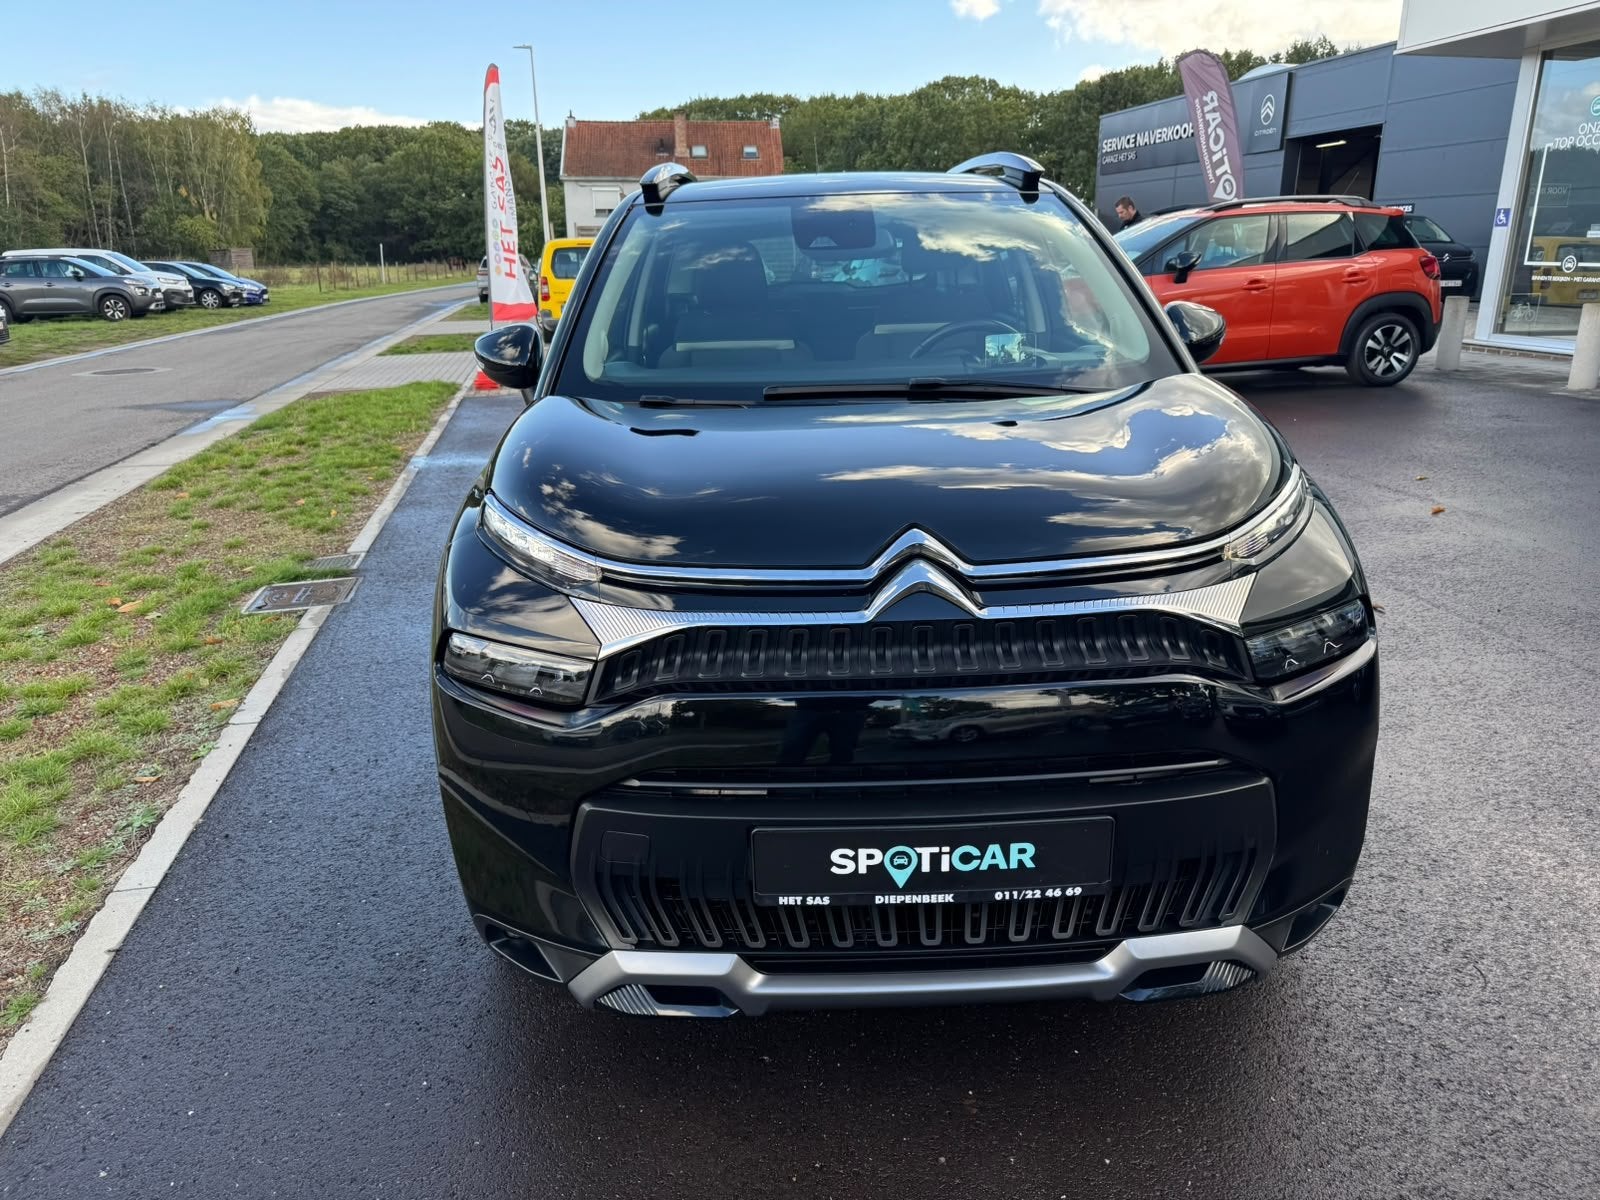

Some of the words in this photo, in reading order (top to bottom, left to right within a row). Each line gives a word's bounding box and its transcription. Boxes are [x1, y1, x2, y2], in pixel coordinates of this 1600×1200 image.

[1102, 133, 1136, 153] SERVICE
[1554, 136, 1575, 149] TOP
[1576, 134, 1600, 147] OCC
[500, 220, 517, 280] HET
[778, 896, 803, 905] HET
[805, 896, 831, 905] SAS
[874, 893, 955, 905] DIEPENBEEK
[994, 889, 1042, 901] 011/22
[1044, 887, 1062, 898] 46
[1065, 886, 1082, 897] 69
